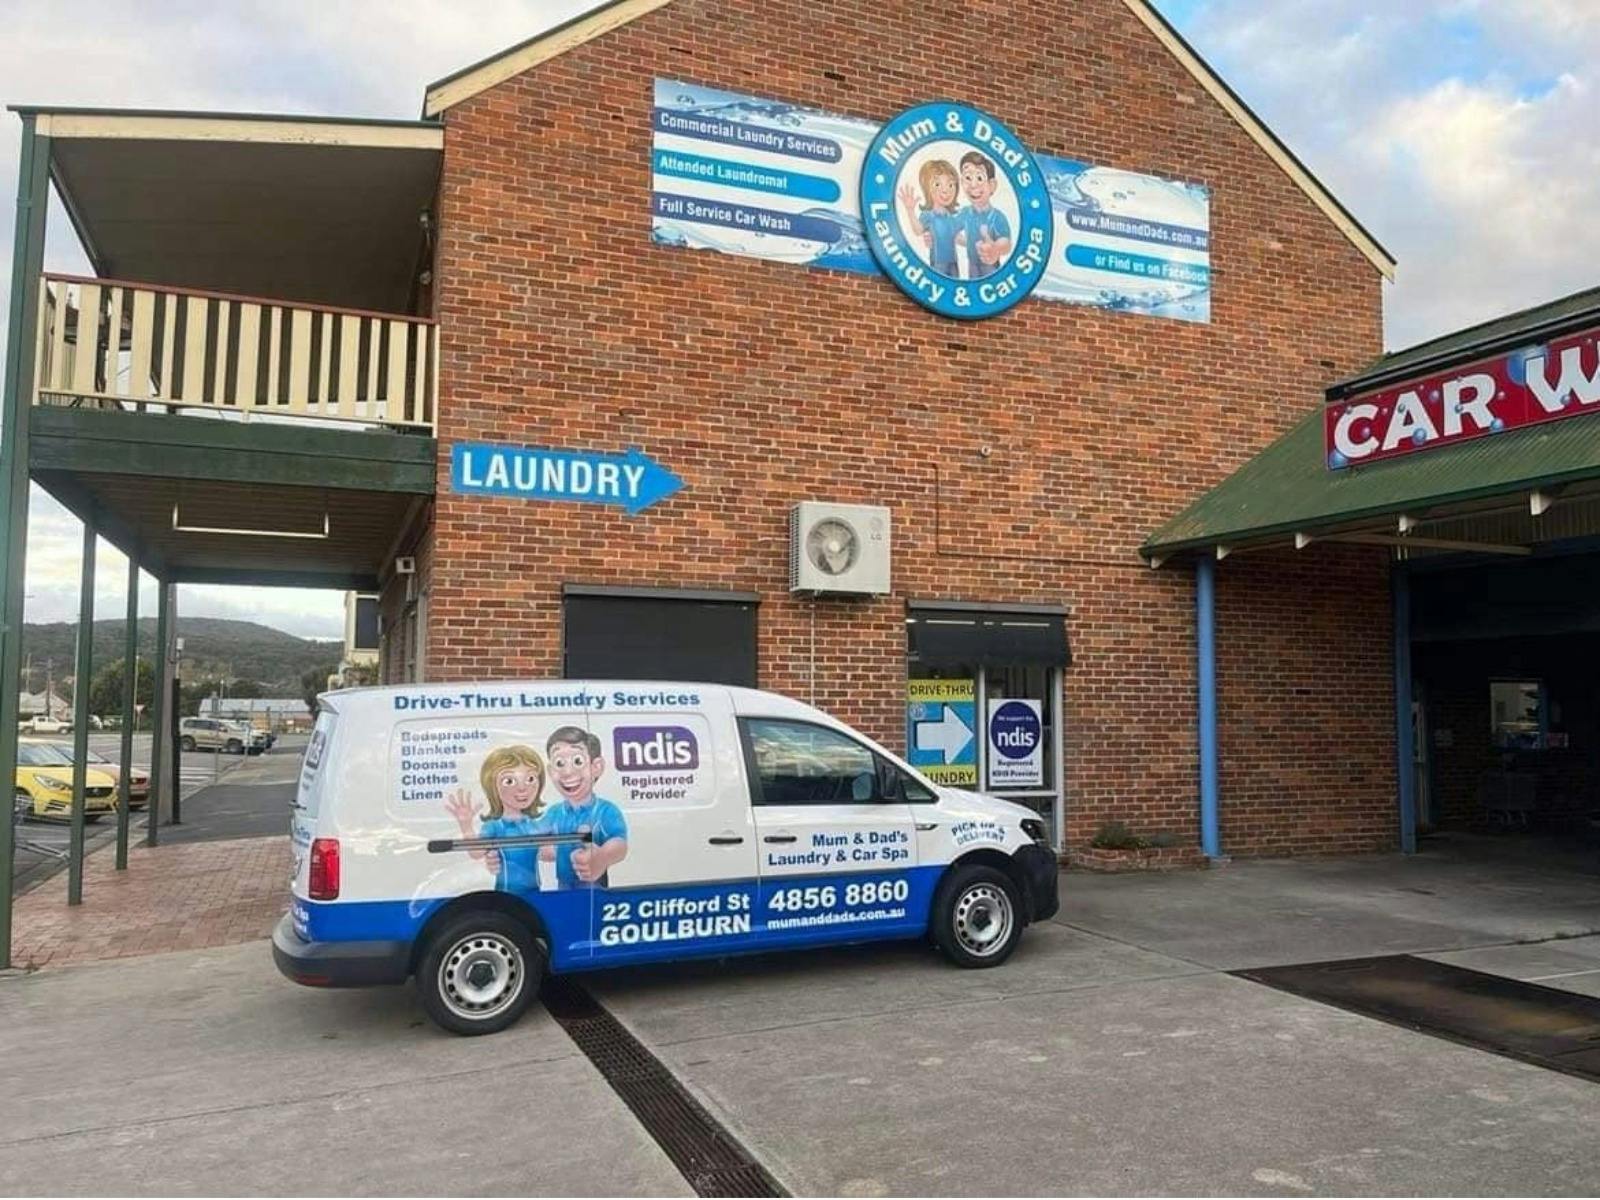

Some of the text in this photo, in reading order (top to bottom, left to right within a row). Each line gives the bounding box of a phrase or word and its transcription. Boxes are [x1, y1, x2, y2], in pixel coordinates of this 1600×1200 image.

[661, 112, 836, 157] Commercial Laundry Services
[878, 111, 1033, 187] Mum & Dad's
[660, 155, 788, 189] Attended Laundromat
[660, 199, 791, 230] Full Service Car Wash
[870, 202, 1044, 307] Laundry & Car Spa
[1094, 254, 1106, 267] or
[1108, 255, 1131, 271] Find
[1133, 260, 1146, 273] us
[1147, 263, 1160, 276] on
[1334, 373, 1497, 458] CAR
[461, 452, 645, 497] LAUNDRY
[394, 692, 700, 710] Drive-Thru Laundry Services
[910, 685, 974, 696] DRIVE-THRU
[997, 726, 1035, 747] ndis
[401, 745, 467, 756] Blankets
[621, 732, 692, 766] ndis
[401, 760, 457, 771] Doonas
[401, 773, 458, 786] Clothes
[621, 774, 694, 788] Registered
[924, 771, 974, 784] UNDRY
[401, 789, 443, 801] Linen
[631, 788, 686, 800] Provider
[812, 830, 908, 847] Mum & Dad's
[768, 847, 909, 866] Laundry & Car Spa
[768, 879, 909, 912] 4856 8860
[602, 893, 750, 921] 22 Clifford St
[767, 907, 905, 929] mumanddads.com.au
[599, 914, 751, 946] GOULBURN
